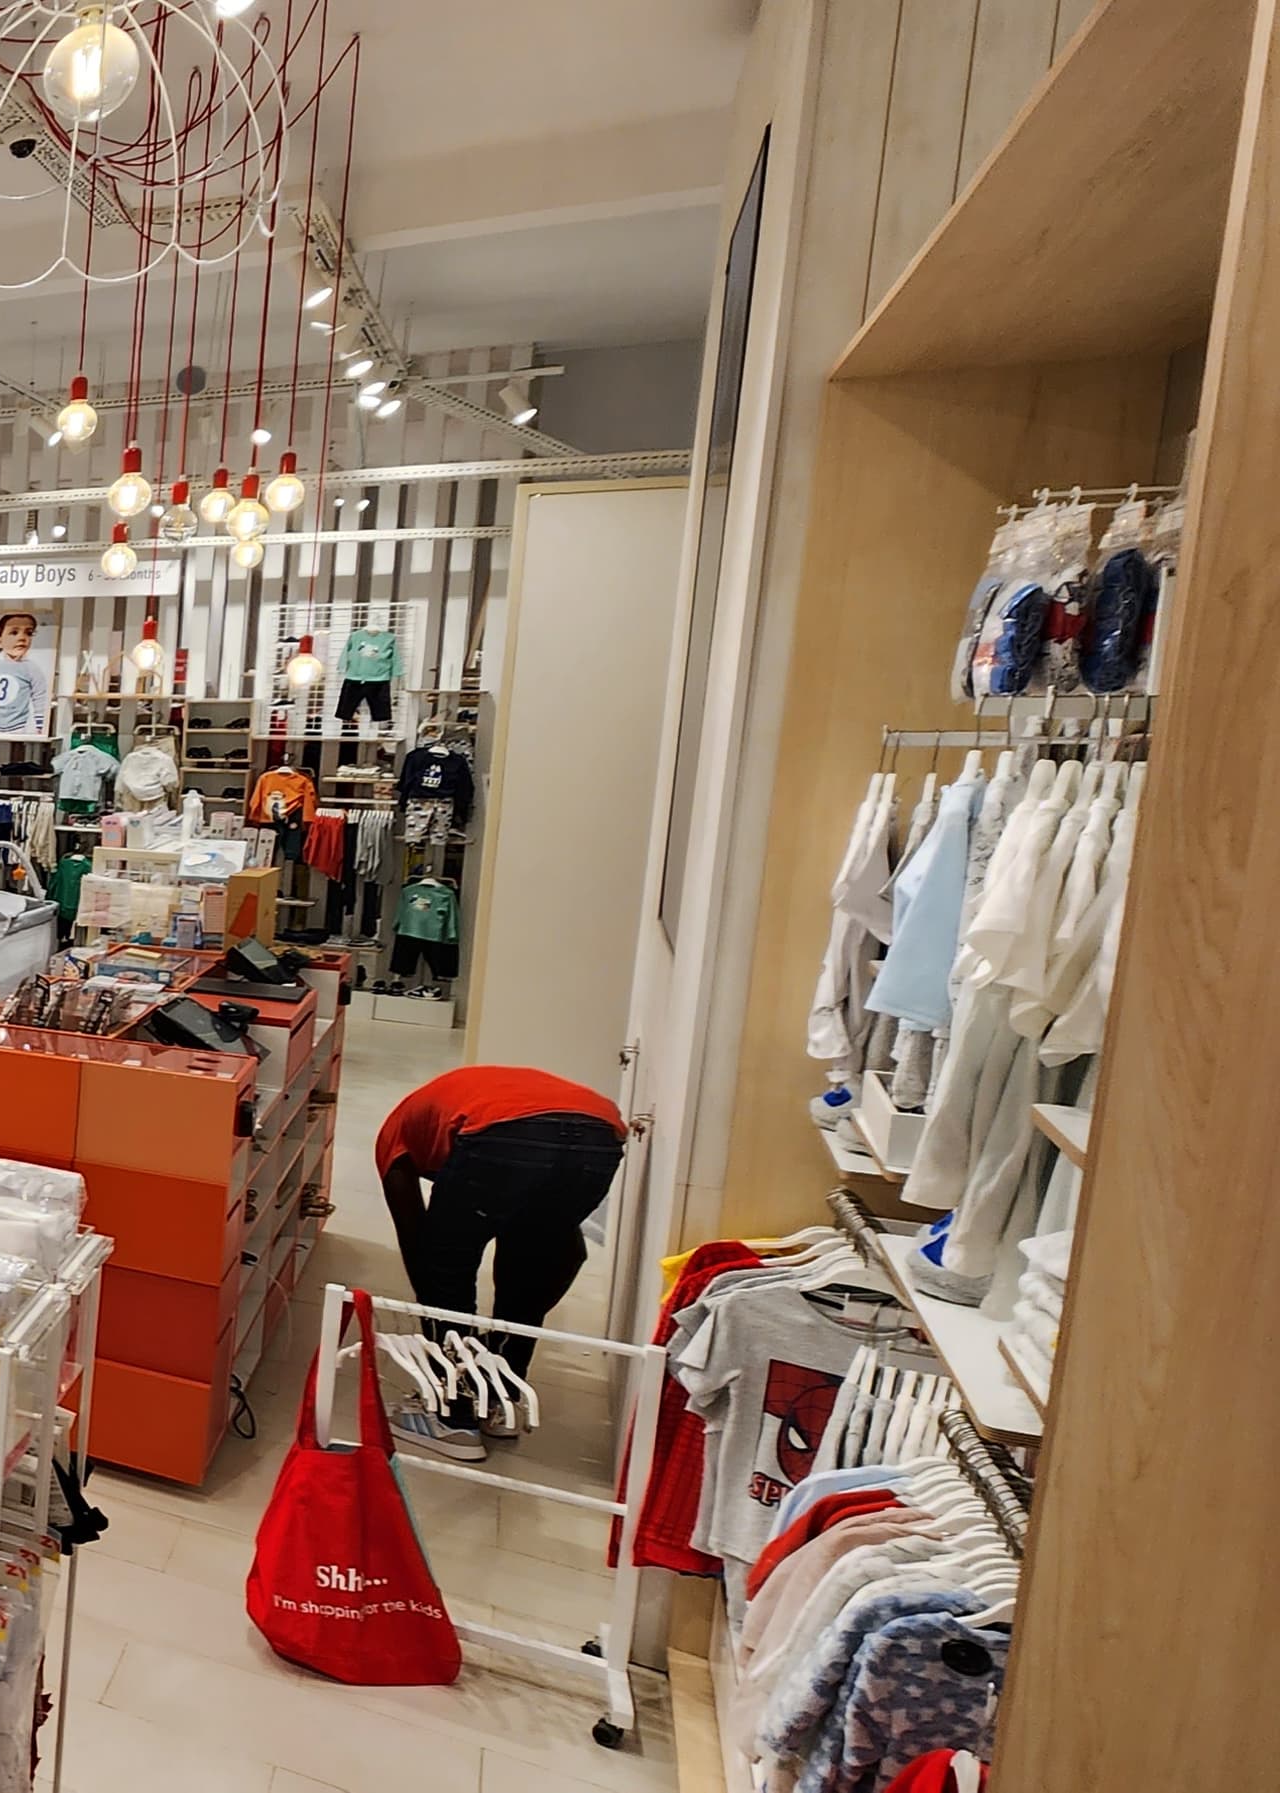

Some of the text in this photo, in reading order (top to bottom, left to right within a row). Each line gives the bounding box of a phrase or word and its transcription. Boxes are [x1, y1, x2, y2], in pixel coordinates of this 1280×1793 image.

[35, 563, 76, 586] Boys
[88, 569, 95, 582] 6
[5, 1563, 28, 1580] ZY
[273, 1594, 297, 1611] I'm
[410, 1600, 443, 1619] kids
